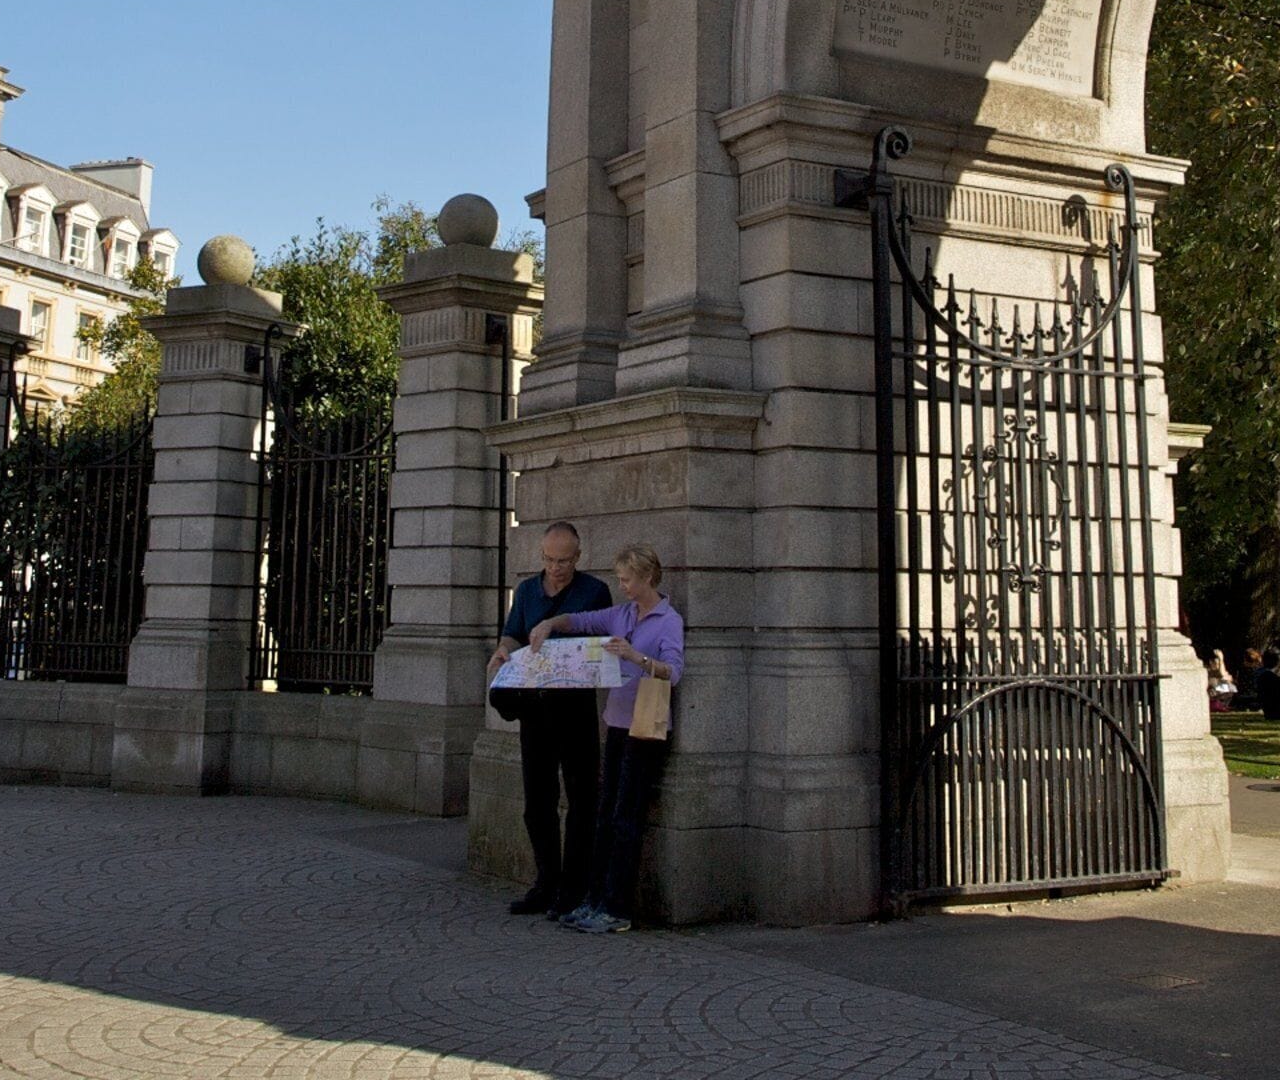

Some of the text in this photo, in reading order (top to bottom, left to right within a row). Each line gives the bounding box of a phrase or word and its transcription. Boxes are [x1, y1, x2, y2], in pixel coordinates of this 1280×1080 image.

[870, 9, 896, 25] LEARY
[958, 4, 985, 20] LYNCH
[869, 20, 904, 38] MURPHY
[1039, 22, 1071, 38] BENNETT
[868, 33, 898, 50] MOORE
[954, 38, 982, 53] BYRNE
[954, 49, 982, 65] BYRNE
